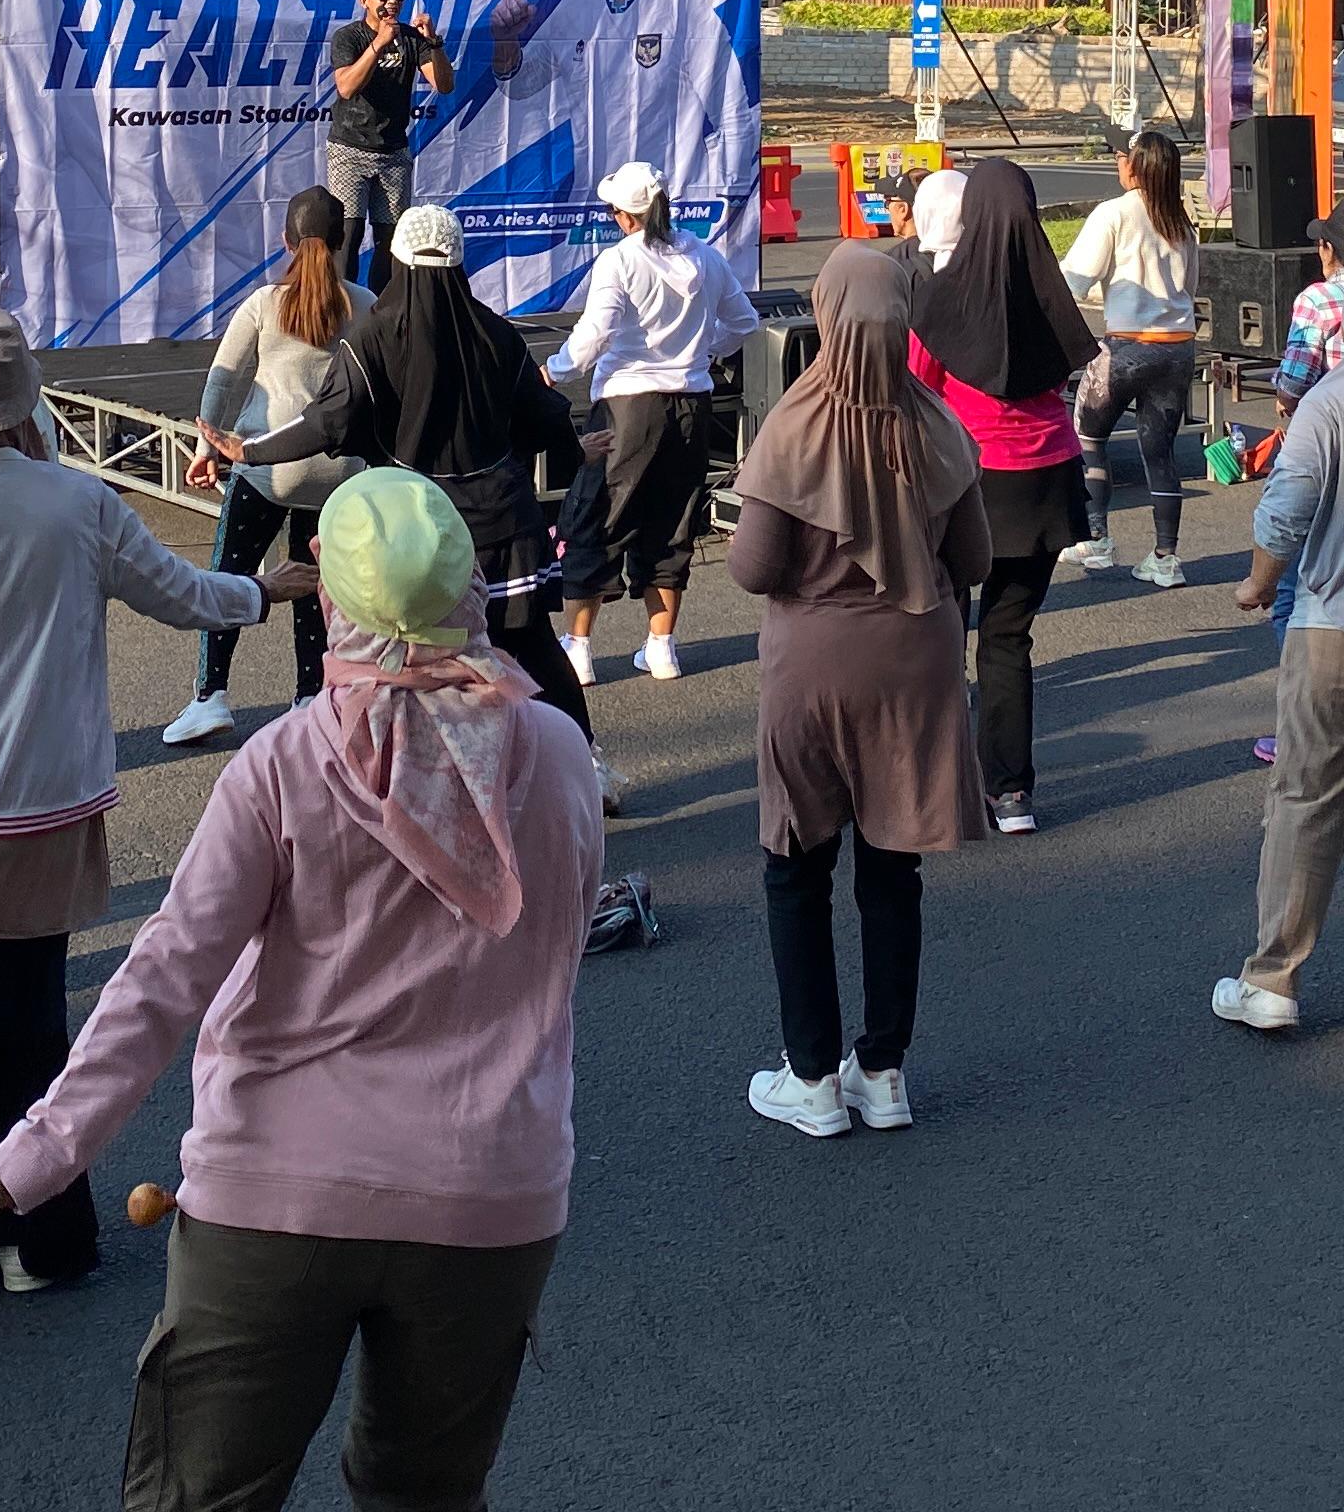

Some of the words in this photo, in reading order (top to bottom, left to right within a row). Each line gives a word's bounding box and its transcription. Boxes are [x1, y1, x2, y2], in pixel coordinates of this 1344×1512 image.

[108, 107, 231, 127] Kawasan
[239, 101, 334, 124] Stadion
[464, 214, 490, 228] DR.
[493, 211, 534, 226] Aries
[536, 211, 585, 226] Agung
